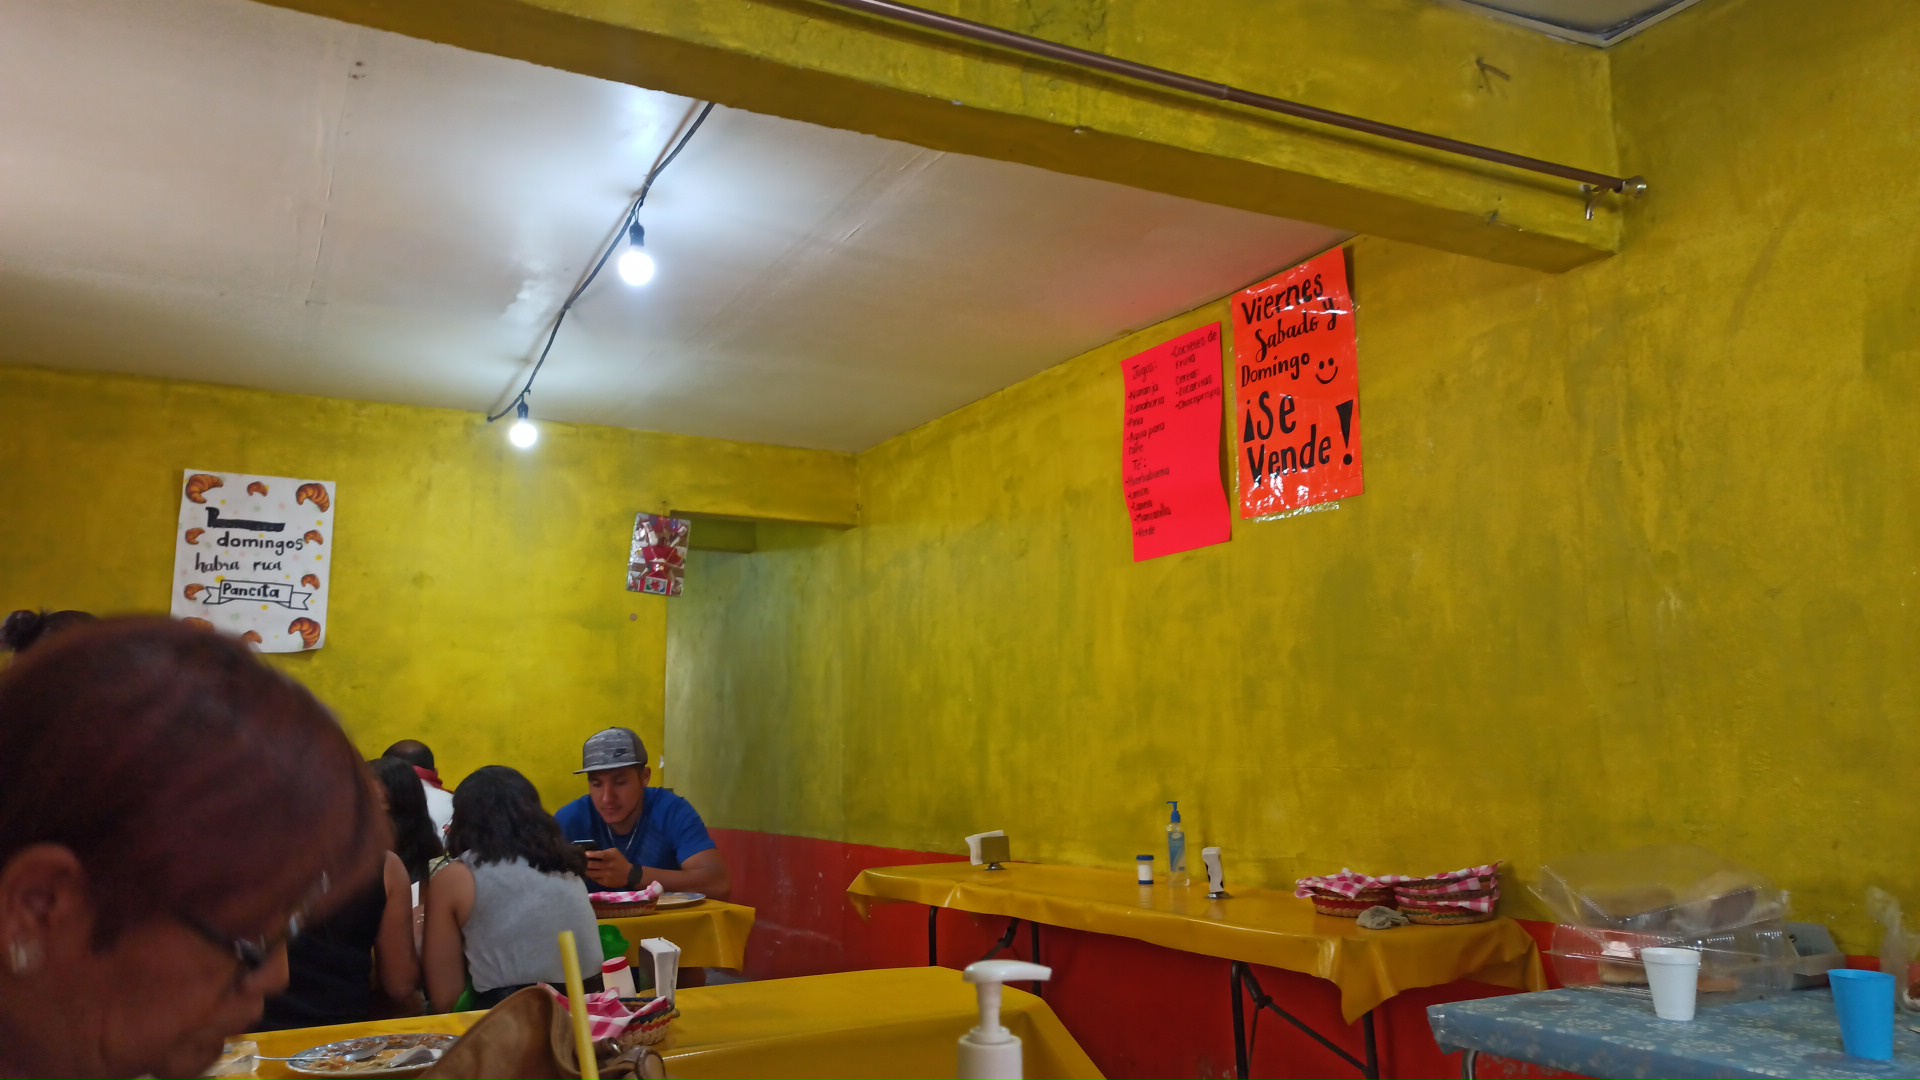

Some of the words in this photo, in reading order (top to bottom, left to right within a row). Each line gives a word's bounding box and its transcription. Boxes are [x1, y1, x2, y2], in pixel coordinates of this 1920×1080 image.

[1241, 274, 1324, 324] Viernes
[1208, 330, 1217, 341] de
[1255, 311, 1320, 362] Sabado
[1322, 298, 1338, 331] y
[1241, 352, 1310, 388] Domingo
[1243, 391, 1296, 443] ¡Se
[1148, 422, 1165, 439] para
[217, 531, 304, 556] domingos
[195, 552, 240, 573] habra
[253, 561, 282, 573] rica
[222, 582, 280, 598] Pancita
